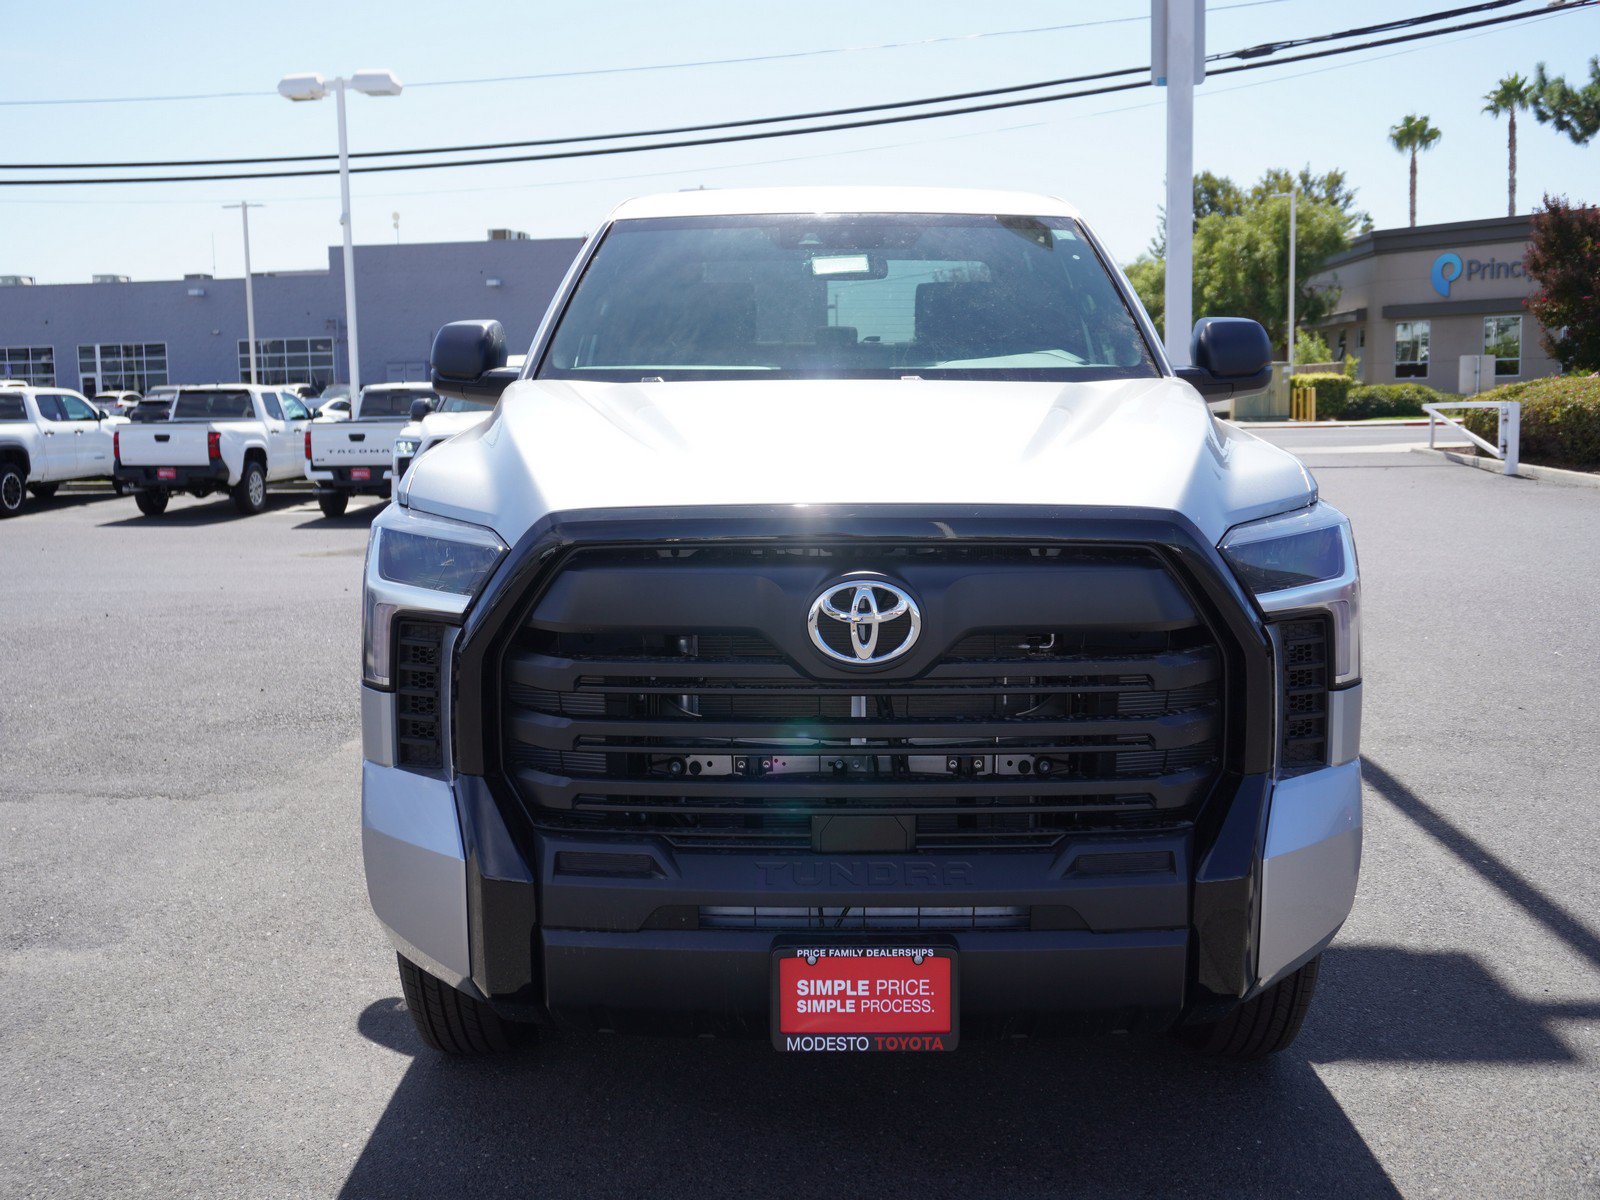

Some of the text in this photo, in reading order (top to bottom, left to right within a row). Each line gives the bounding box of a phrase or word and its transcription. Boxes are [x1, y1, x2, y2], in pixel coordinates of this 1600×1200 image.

[754, 861, 976, 886] TUNDRA
[797, 949, 934, 957] PRICE FAMILY DEALERSHIPS
[797, 980, 935, 995] SIMPLE PRICE.
[797, 1000, 935, 1013] SIMPLE PROCESS.
[787, 1037, 944, 1051] MODESTO TOYOTA
